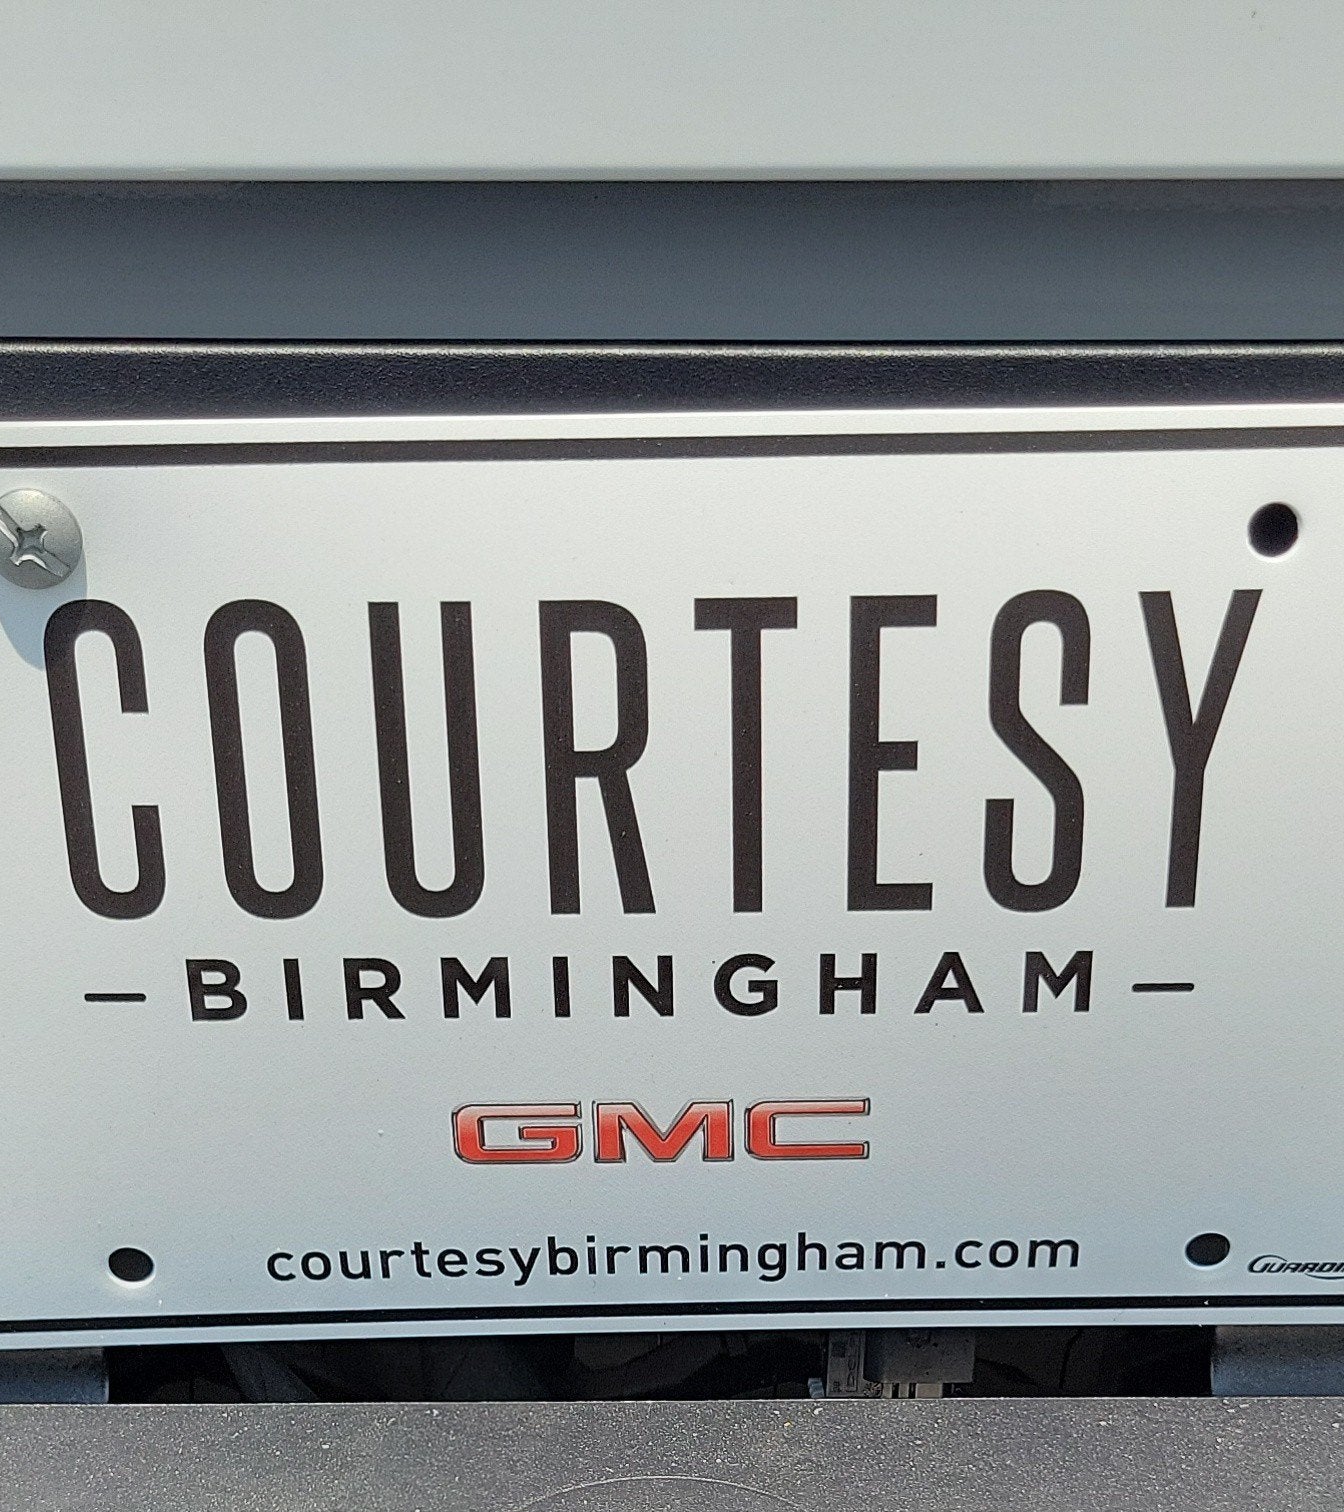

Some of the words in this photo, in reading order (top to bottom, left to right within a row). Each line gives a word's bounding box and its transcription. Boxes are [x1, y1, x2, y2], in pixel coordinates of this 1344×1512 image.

[44, 589, 1264, 920] COURTESY
[185, 950, 1094, 1022] BIRMINGHAM
[450, 1096, 872, 1165] GMC
[266, 1230, 1081, 1286] courtesybirmingham.com
